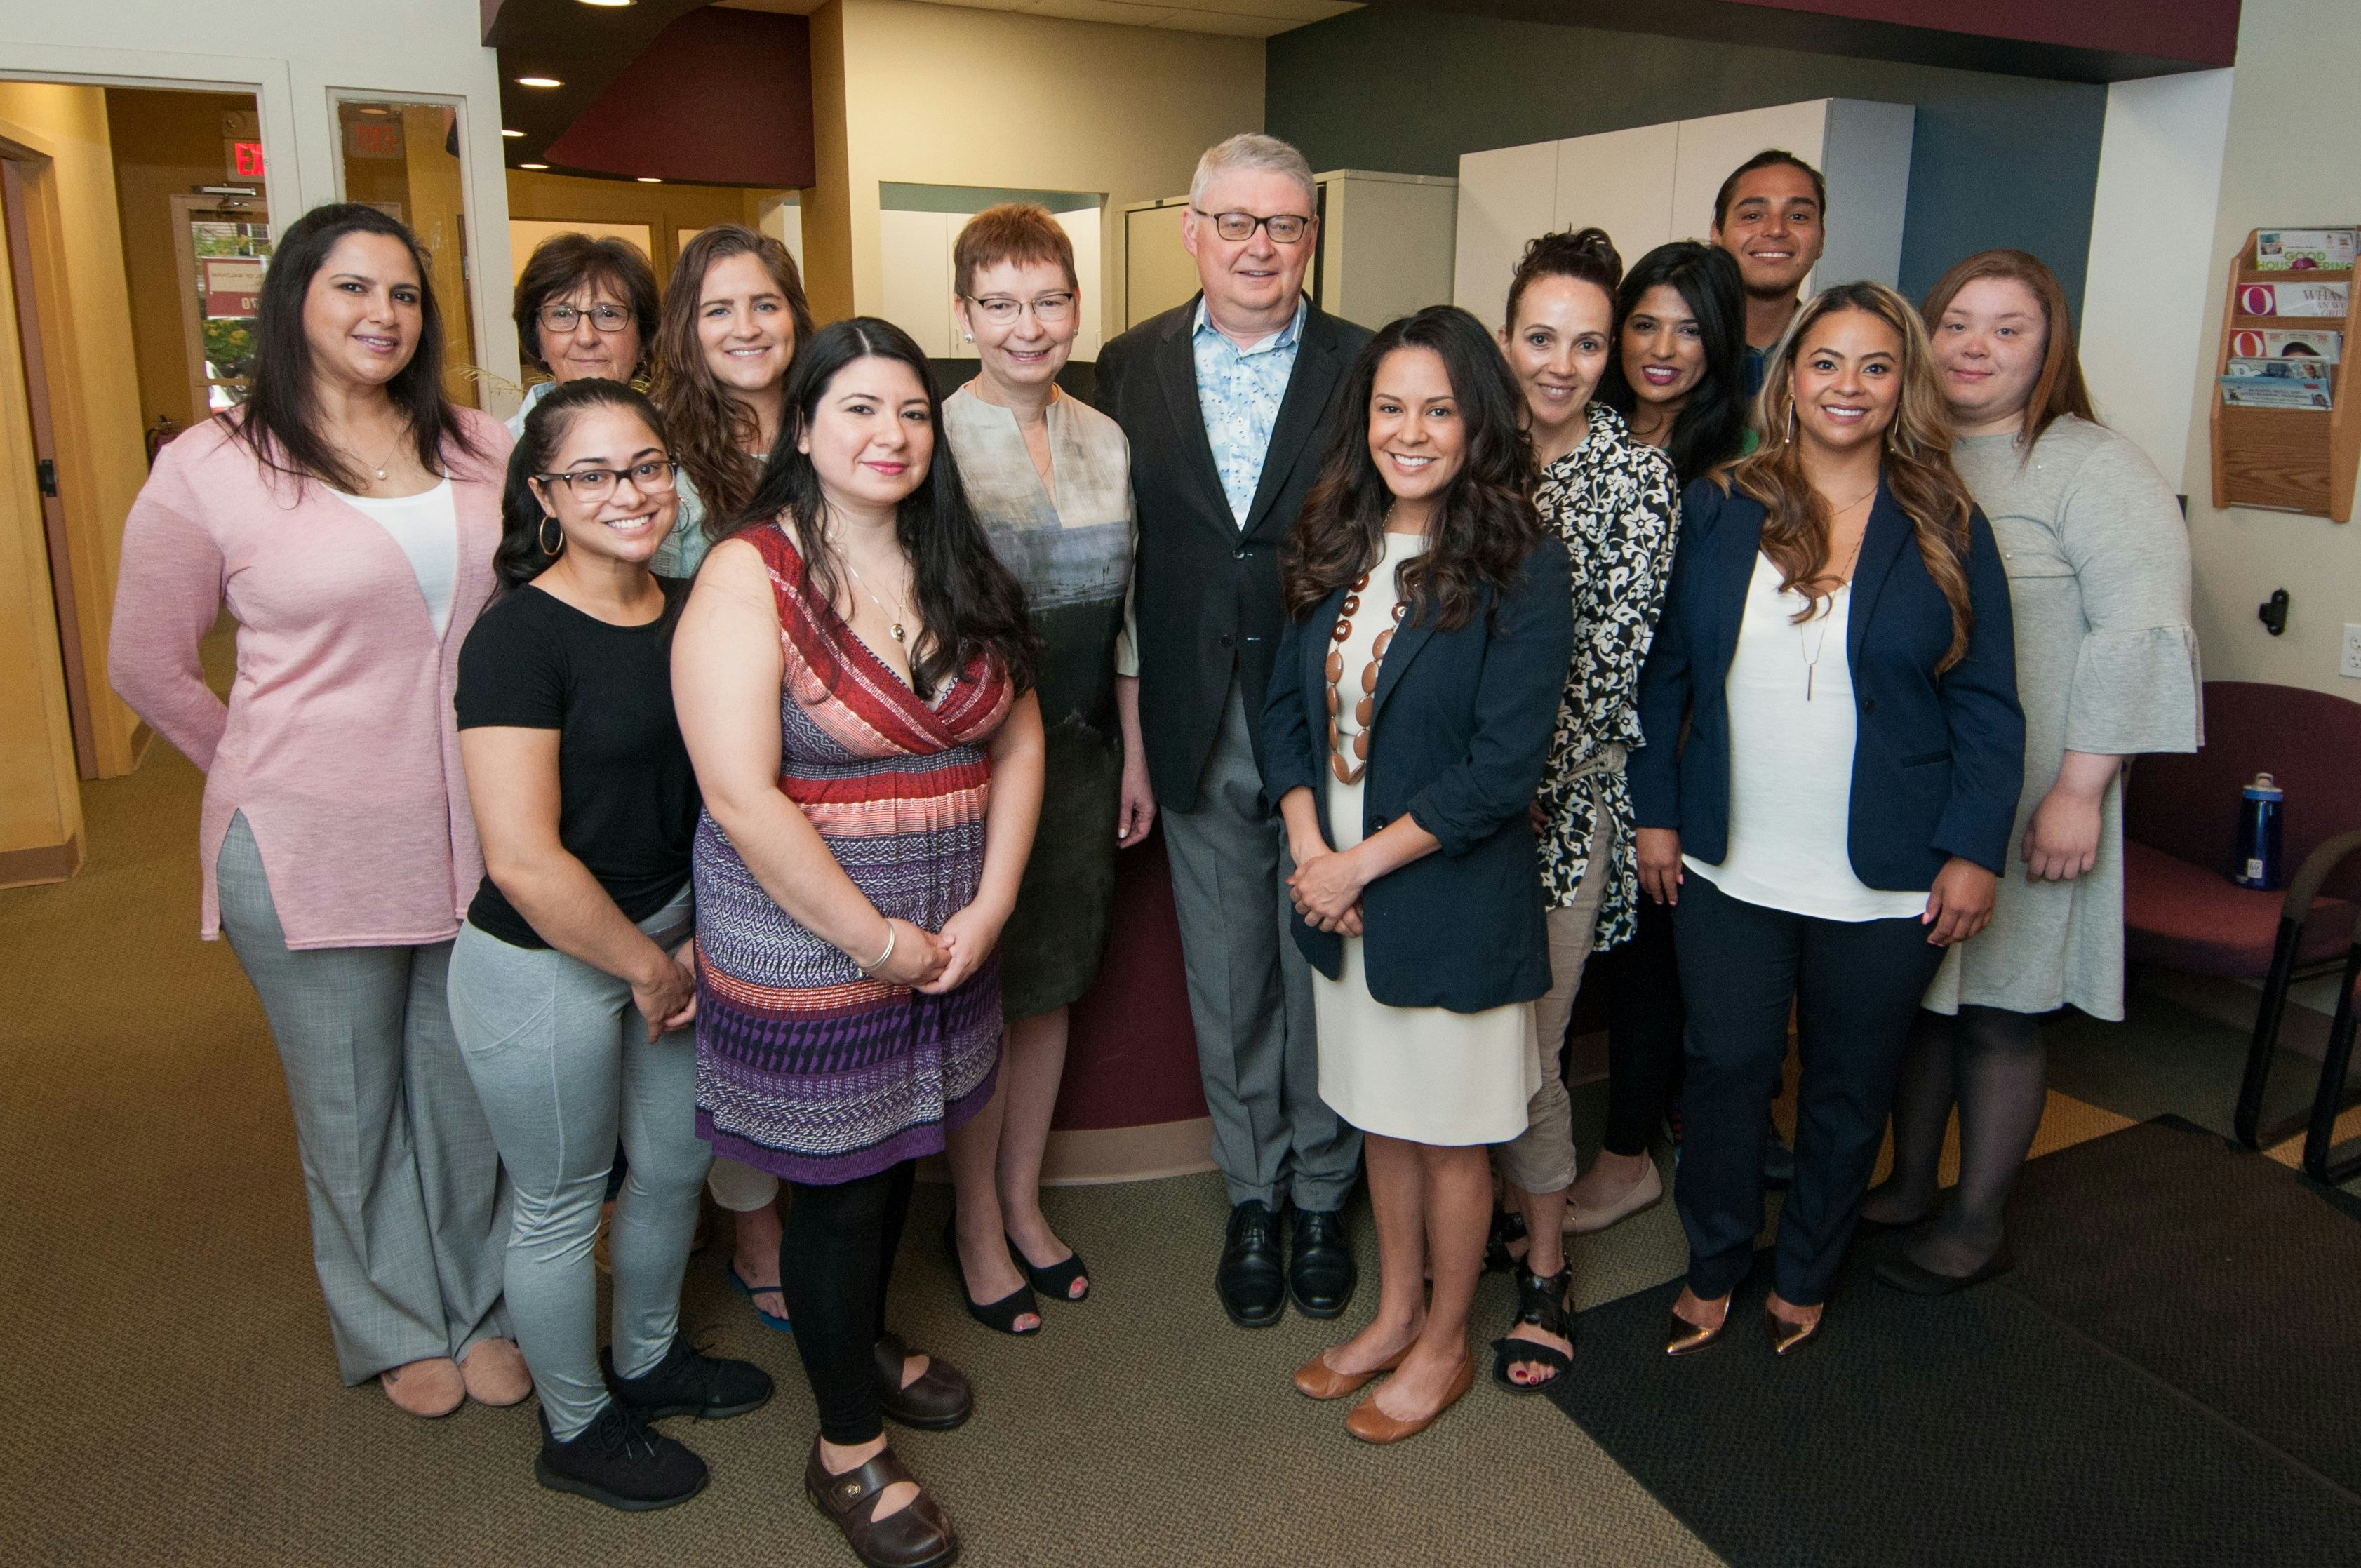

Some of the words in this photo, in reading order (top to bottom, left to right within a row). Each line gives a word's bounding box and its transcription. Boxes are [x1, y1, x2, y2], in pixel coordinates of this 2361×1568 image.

[235, 142, 265, 177] EX
[2285, 251, 2326, 261] GOOD
[2242, 286, 2273, 315] O
[2234, 332, 2264, 356] O
